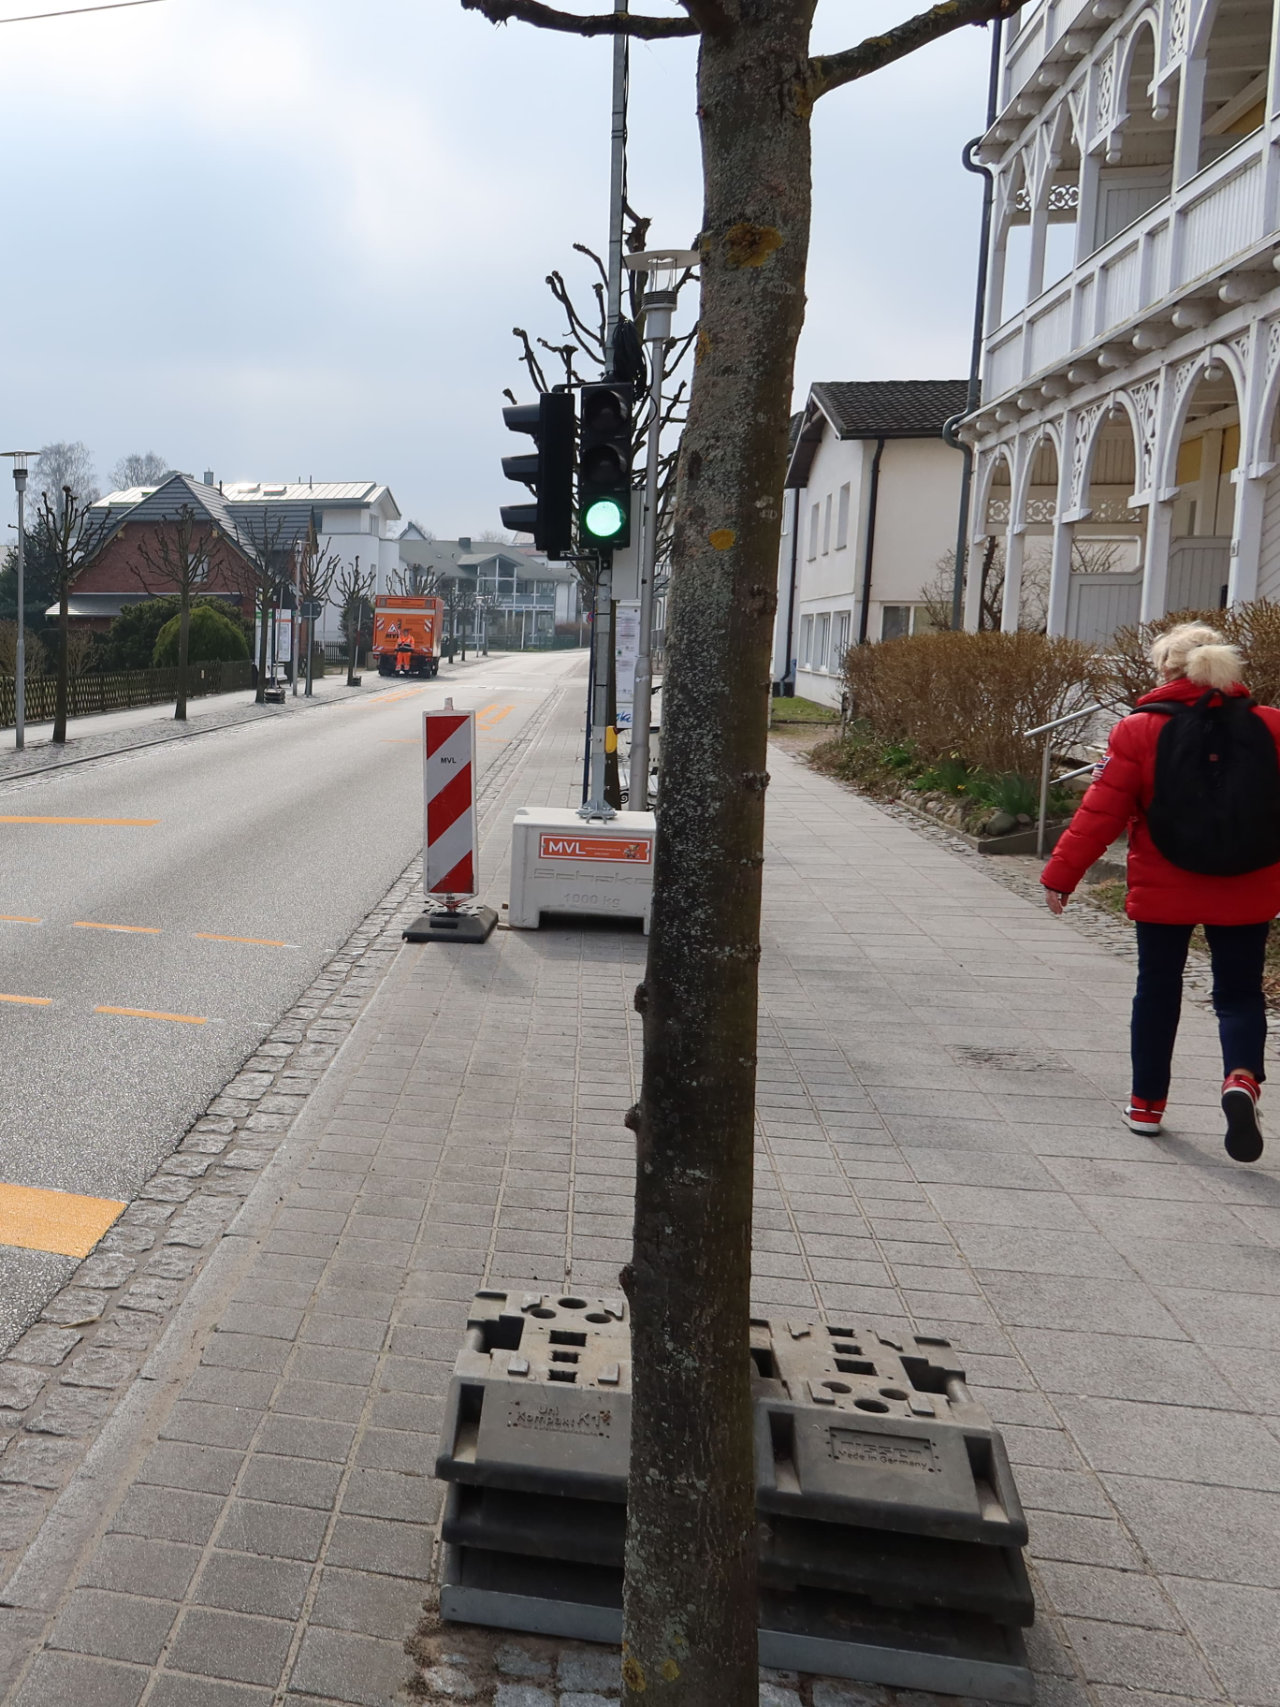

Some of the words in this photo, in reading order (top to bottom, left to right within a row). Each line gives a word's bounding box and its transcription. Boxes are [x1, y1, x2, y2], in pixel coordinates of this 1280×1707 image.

[440, 756, 457, 764] MVL
[549, 841, 586, 854] MVL
[564, 893, 598, 905] 1000
[603, 895, 621, 908] kg
[838, 1449, 866, 1461] Made
[868, 1453, 878, 1461] in
[879, 1455, 927, 1470] Germany
